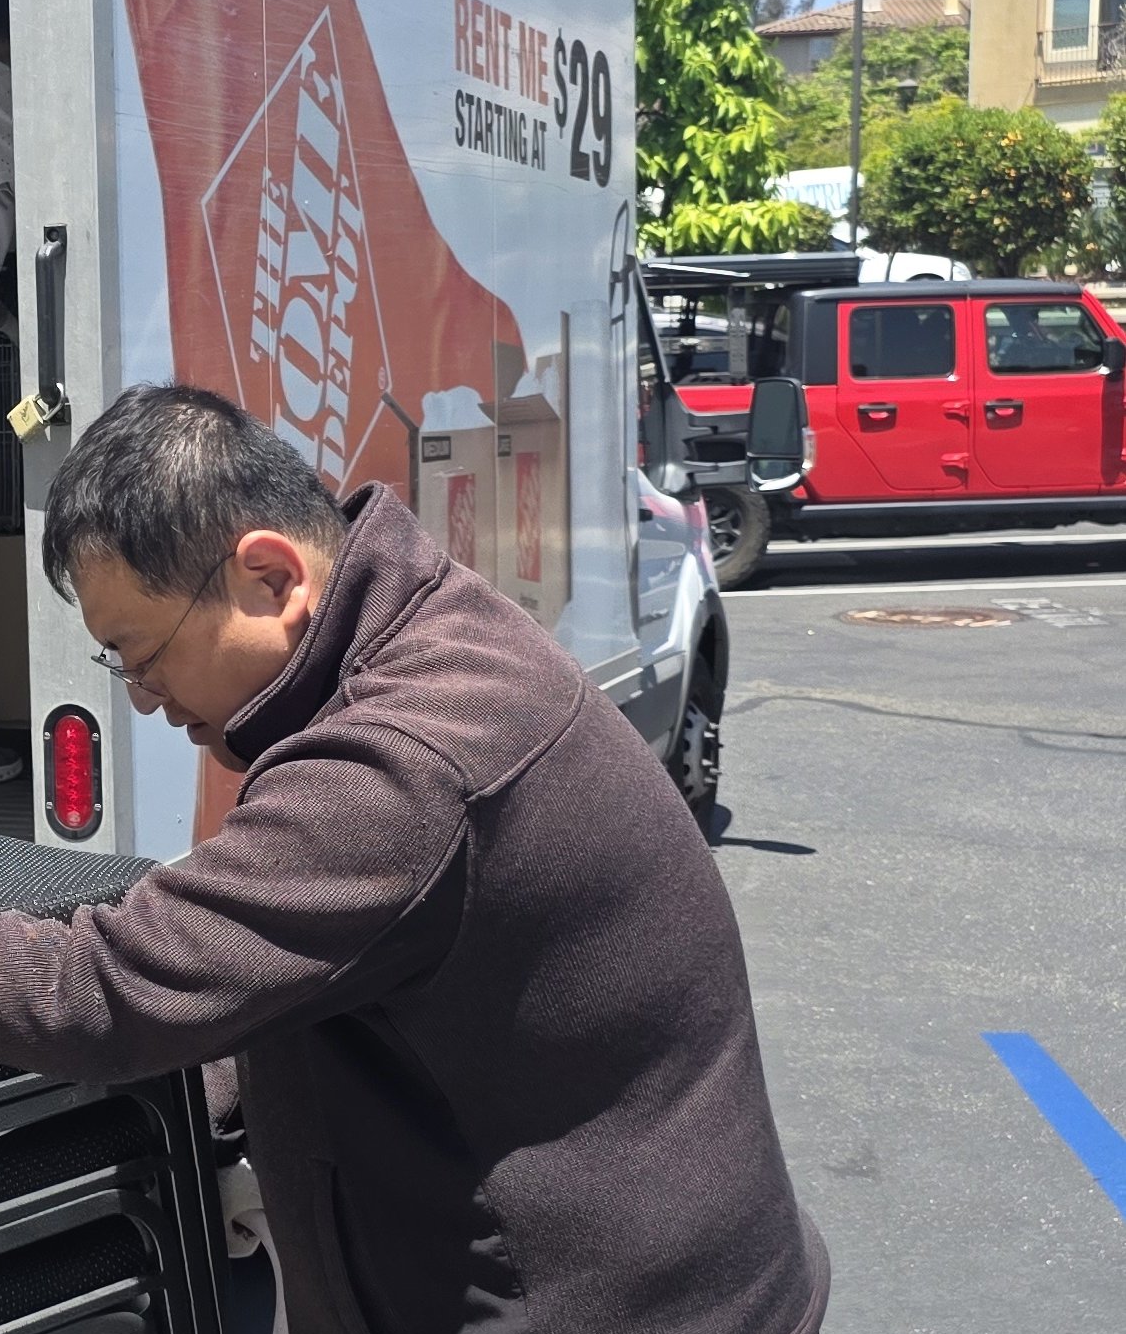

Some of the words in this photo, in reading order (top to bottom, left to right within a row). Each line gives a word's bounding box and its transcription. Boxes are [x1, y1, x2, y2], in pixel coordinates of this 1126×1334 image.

[455, 88, 528, 165] STARTING
[531, 118, 547, 171] AT
[518, 19, 549, 107] ME
[553, 27, 612, 188] $29
[249, 165, 289, 363] THE
[321, 173, 364, 485] DEPOT
